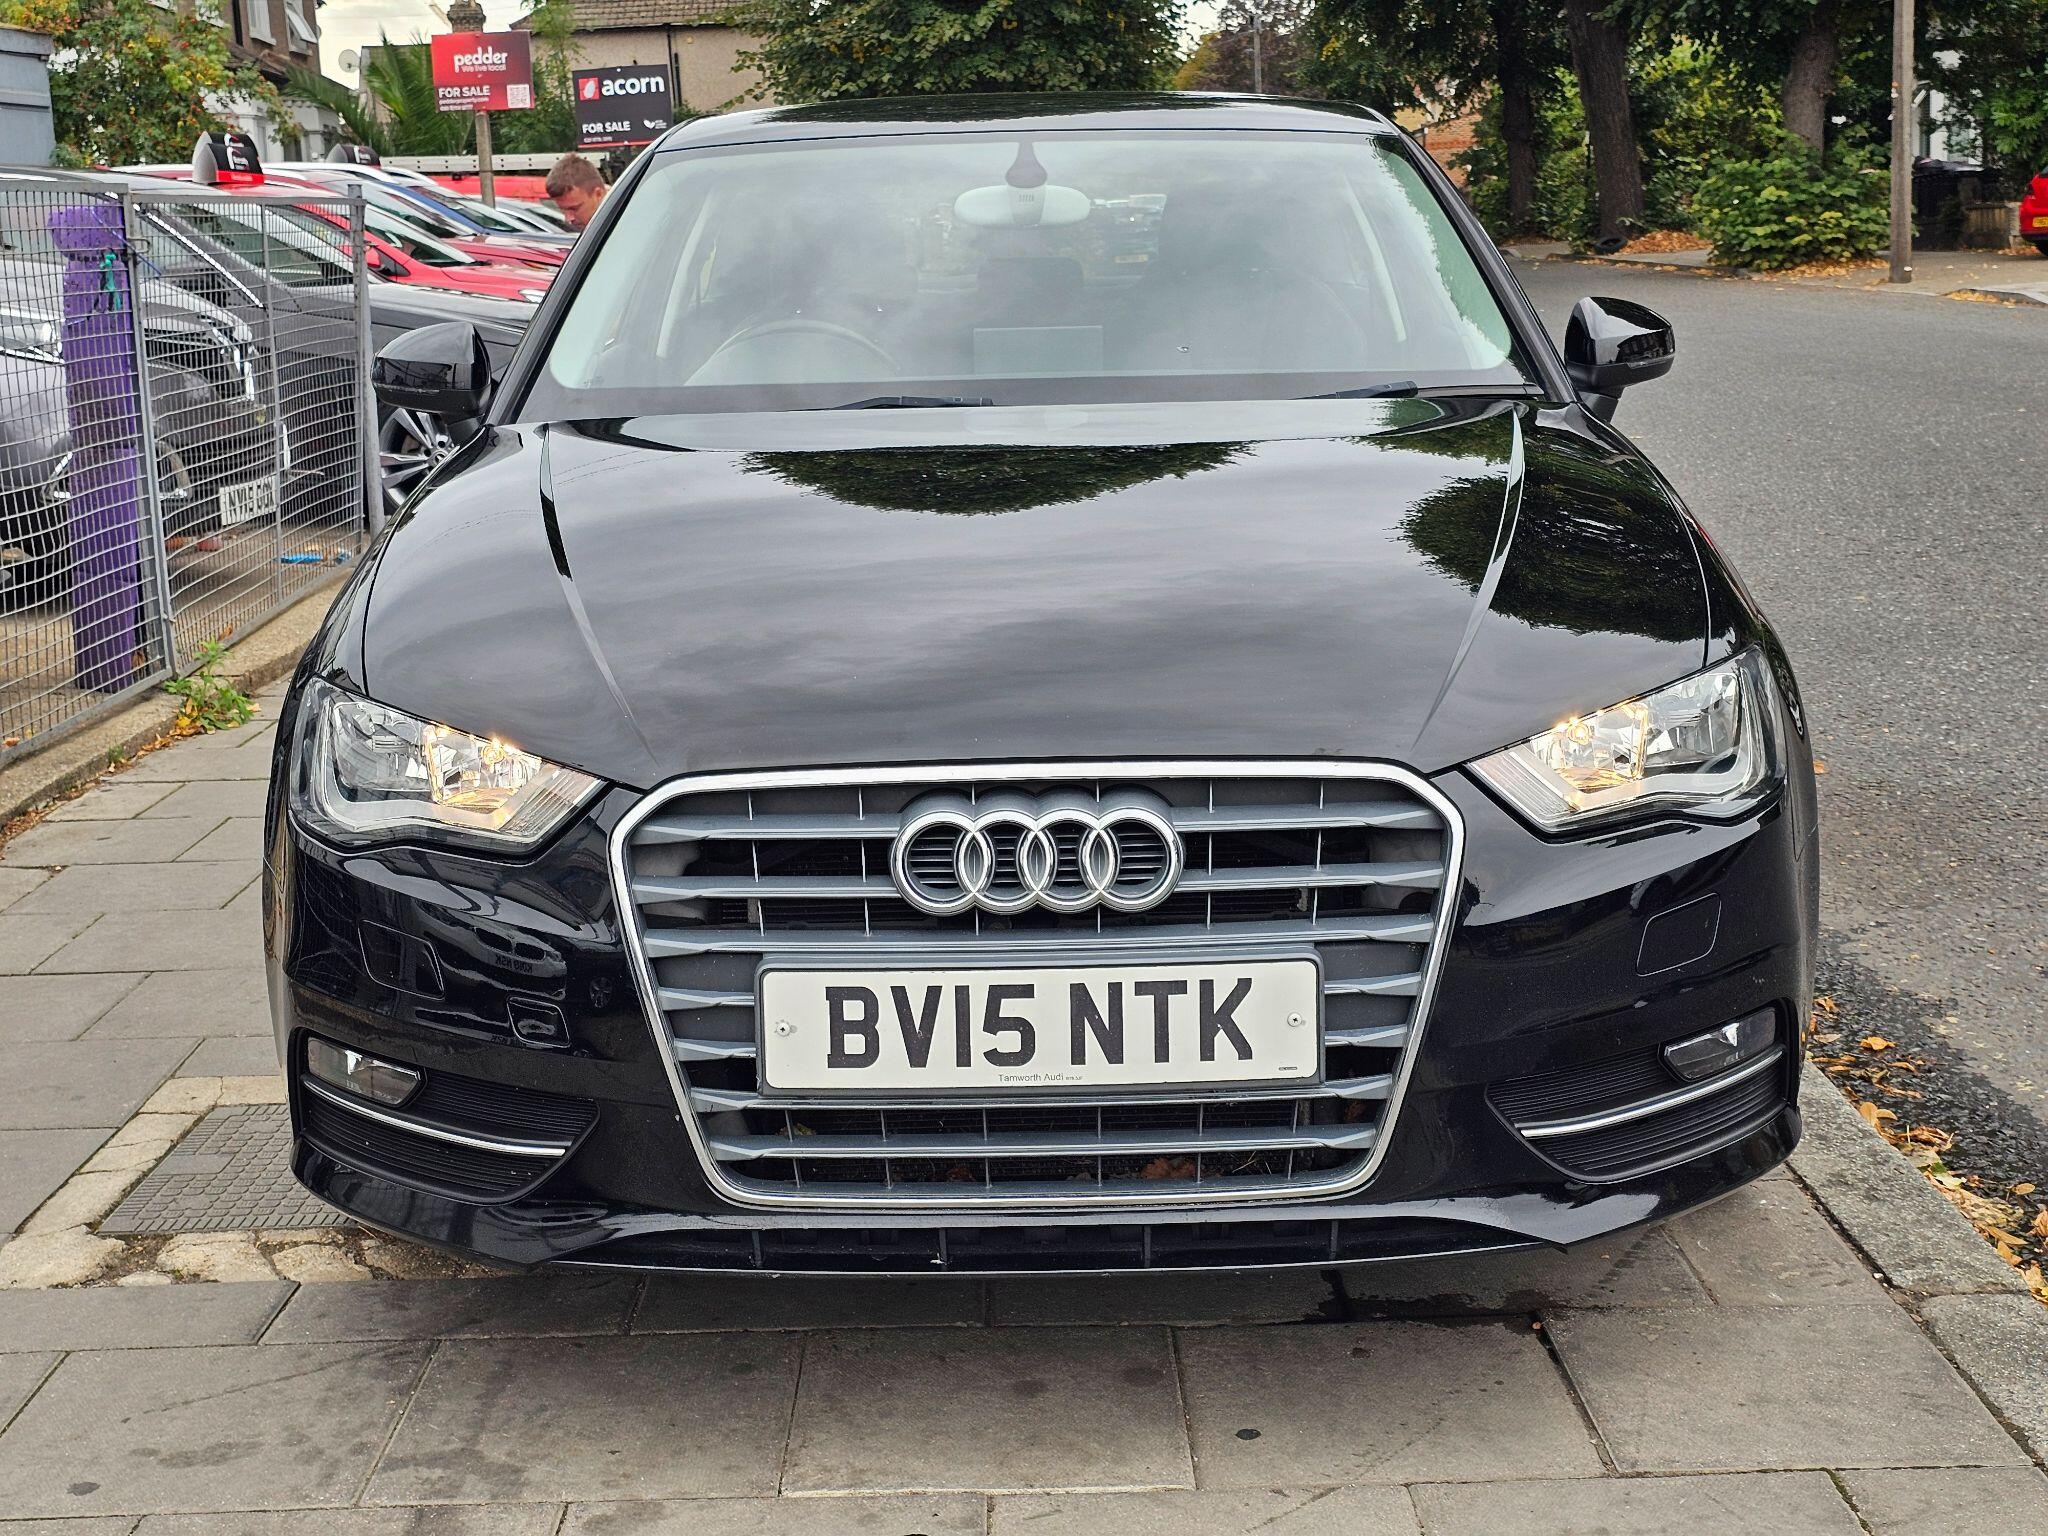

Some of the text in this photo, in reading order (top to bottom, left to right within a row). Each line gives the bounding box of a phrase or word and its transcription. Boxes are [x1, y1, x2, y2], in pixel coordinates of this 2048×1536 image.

[454, 46, 508, 73] pedder
[438, 85, 490, 98] FOR SALE
[601, 76, 665, 96] acorn
[582, 120, 631, 134] FOR SALE
[825, 978, 1253, 1068] BV15 NTK
[999, 1073, 1041, 1082] Tamworth
[1043, 1073, 1063, 1081] Audi
